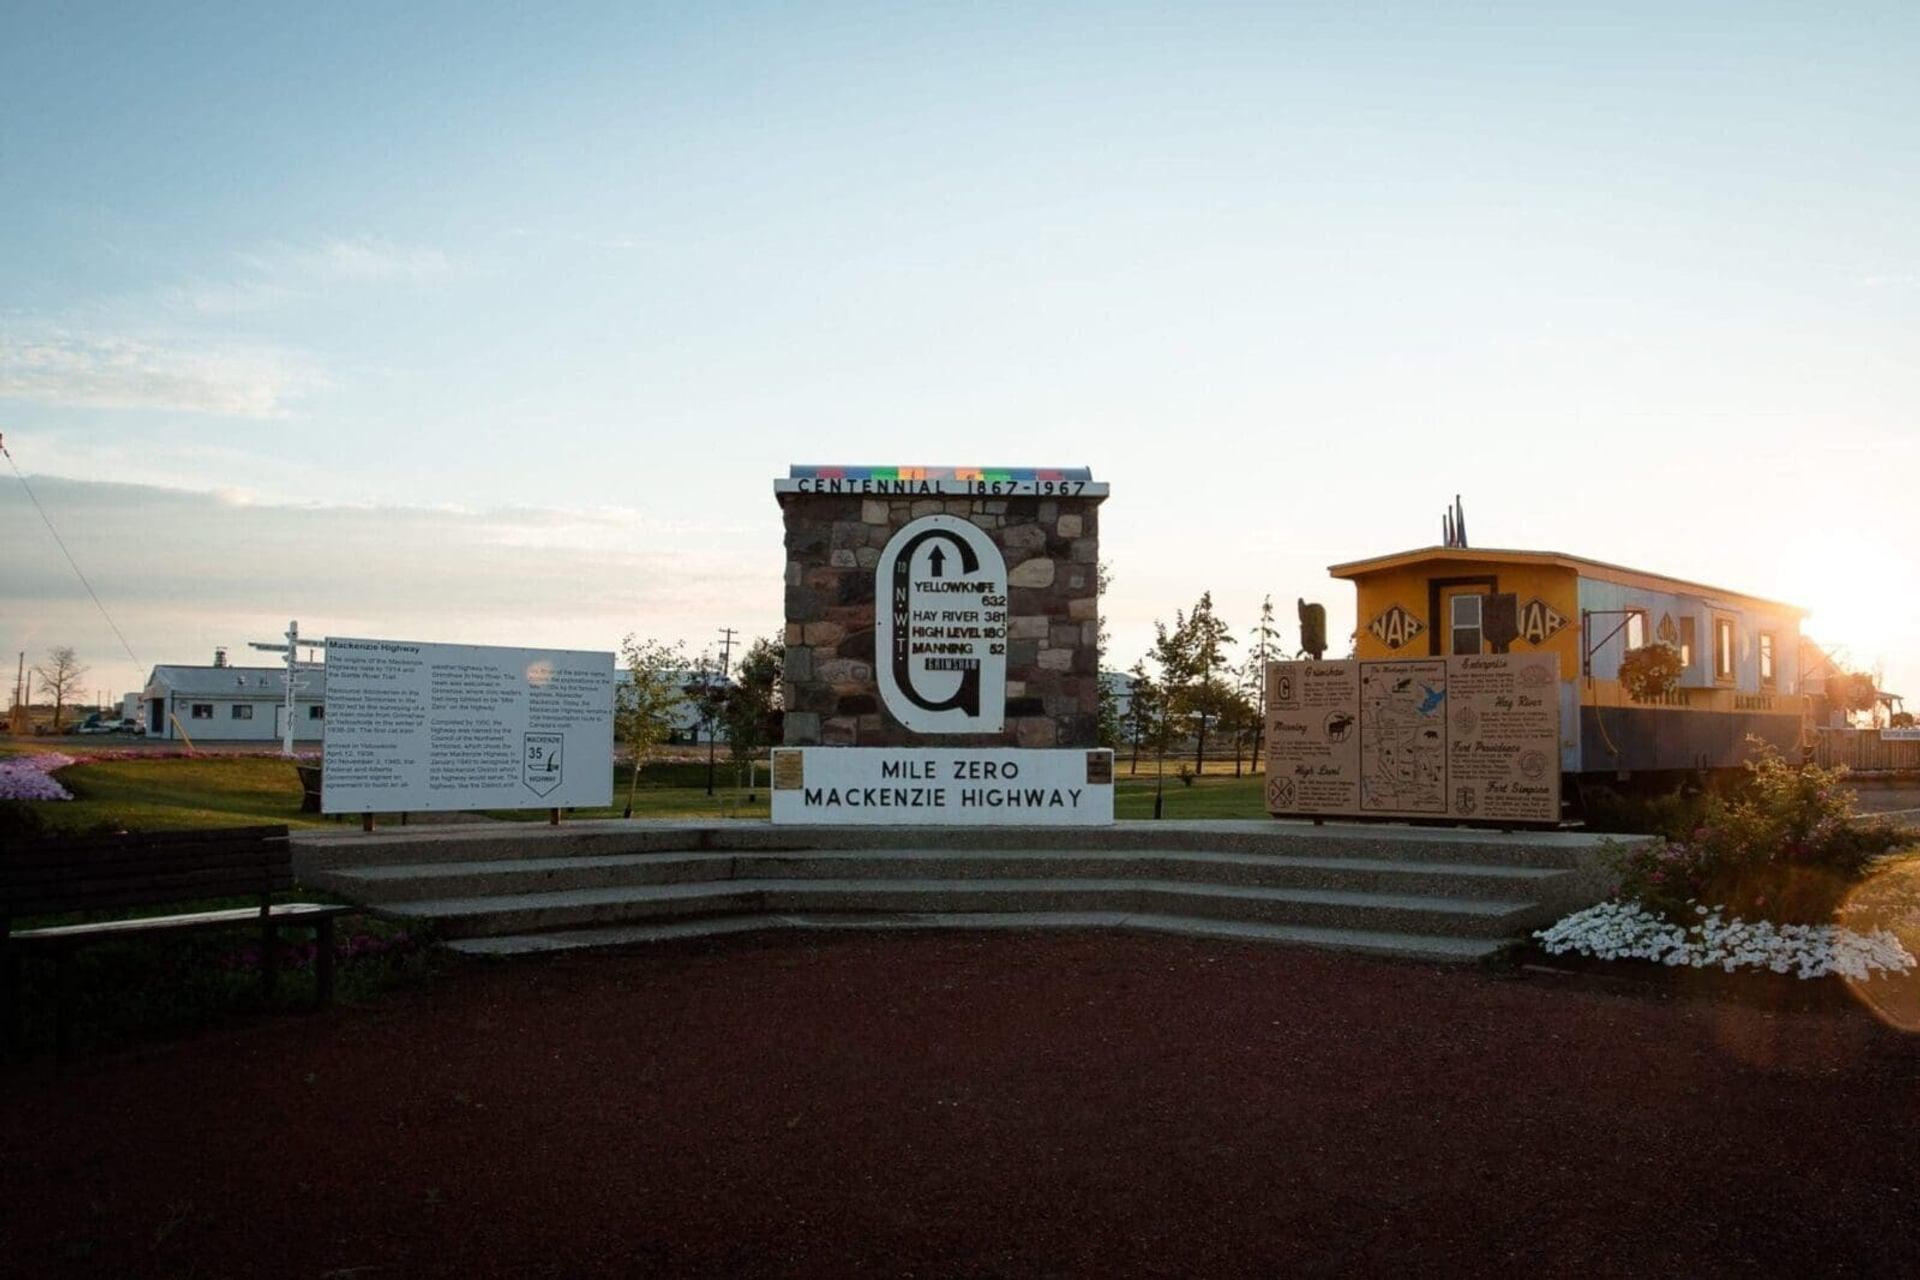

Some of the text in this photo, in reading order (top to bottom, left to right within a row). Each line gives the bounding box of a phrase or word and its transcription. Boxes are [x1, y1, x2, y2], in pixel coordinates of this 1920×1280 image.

[798, 479, 1086, 496] CENTENNIAL 1867-1967
[897, 562, 907, 573] TO
[914, 582, 995, 594] YELLOWKNIFE
[982, 596, 1006, 606] 632
[913, 611, 1006, 622] HAY RIVER 381
[912, 628, 1006, 638] HIGH LEVEL 180
[1372, 610, 1419, 644] NAR
[329, 641, 378, 650] Mackenzie
[381, 644, 420, 654] Highway
[912, 644, 1005, 655] MANNING 52
[927, 659, 979, 670] GRIMSHAW
[1495, 696, 1543, 710] Hay River
[1451, 741, 1521, 752] Fort Providence
[528, 747, 542, 759] 35
[881, 761, 1019, 780] MILE ZERO
[1295, 765, 1340, 776] High Level
[1486, 781, 1549, 795] Fort Simpson
[805, 788, 1082, 807] MACKENZIE HIGHWAY
